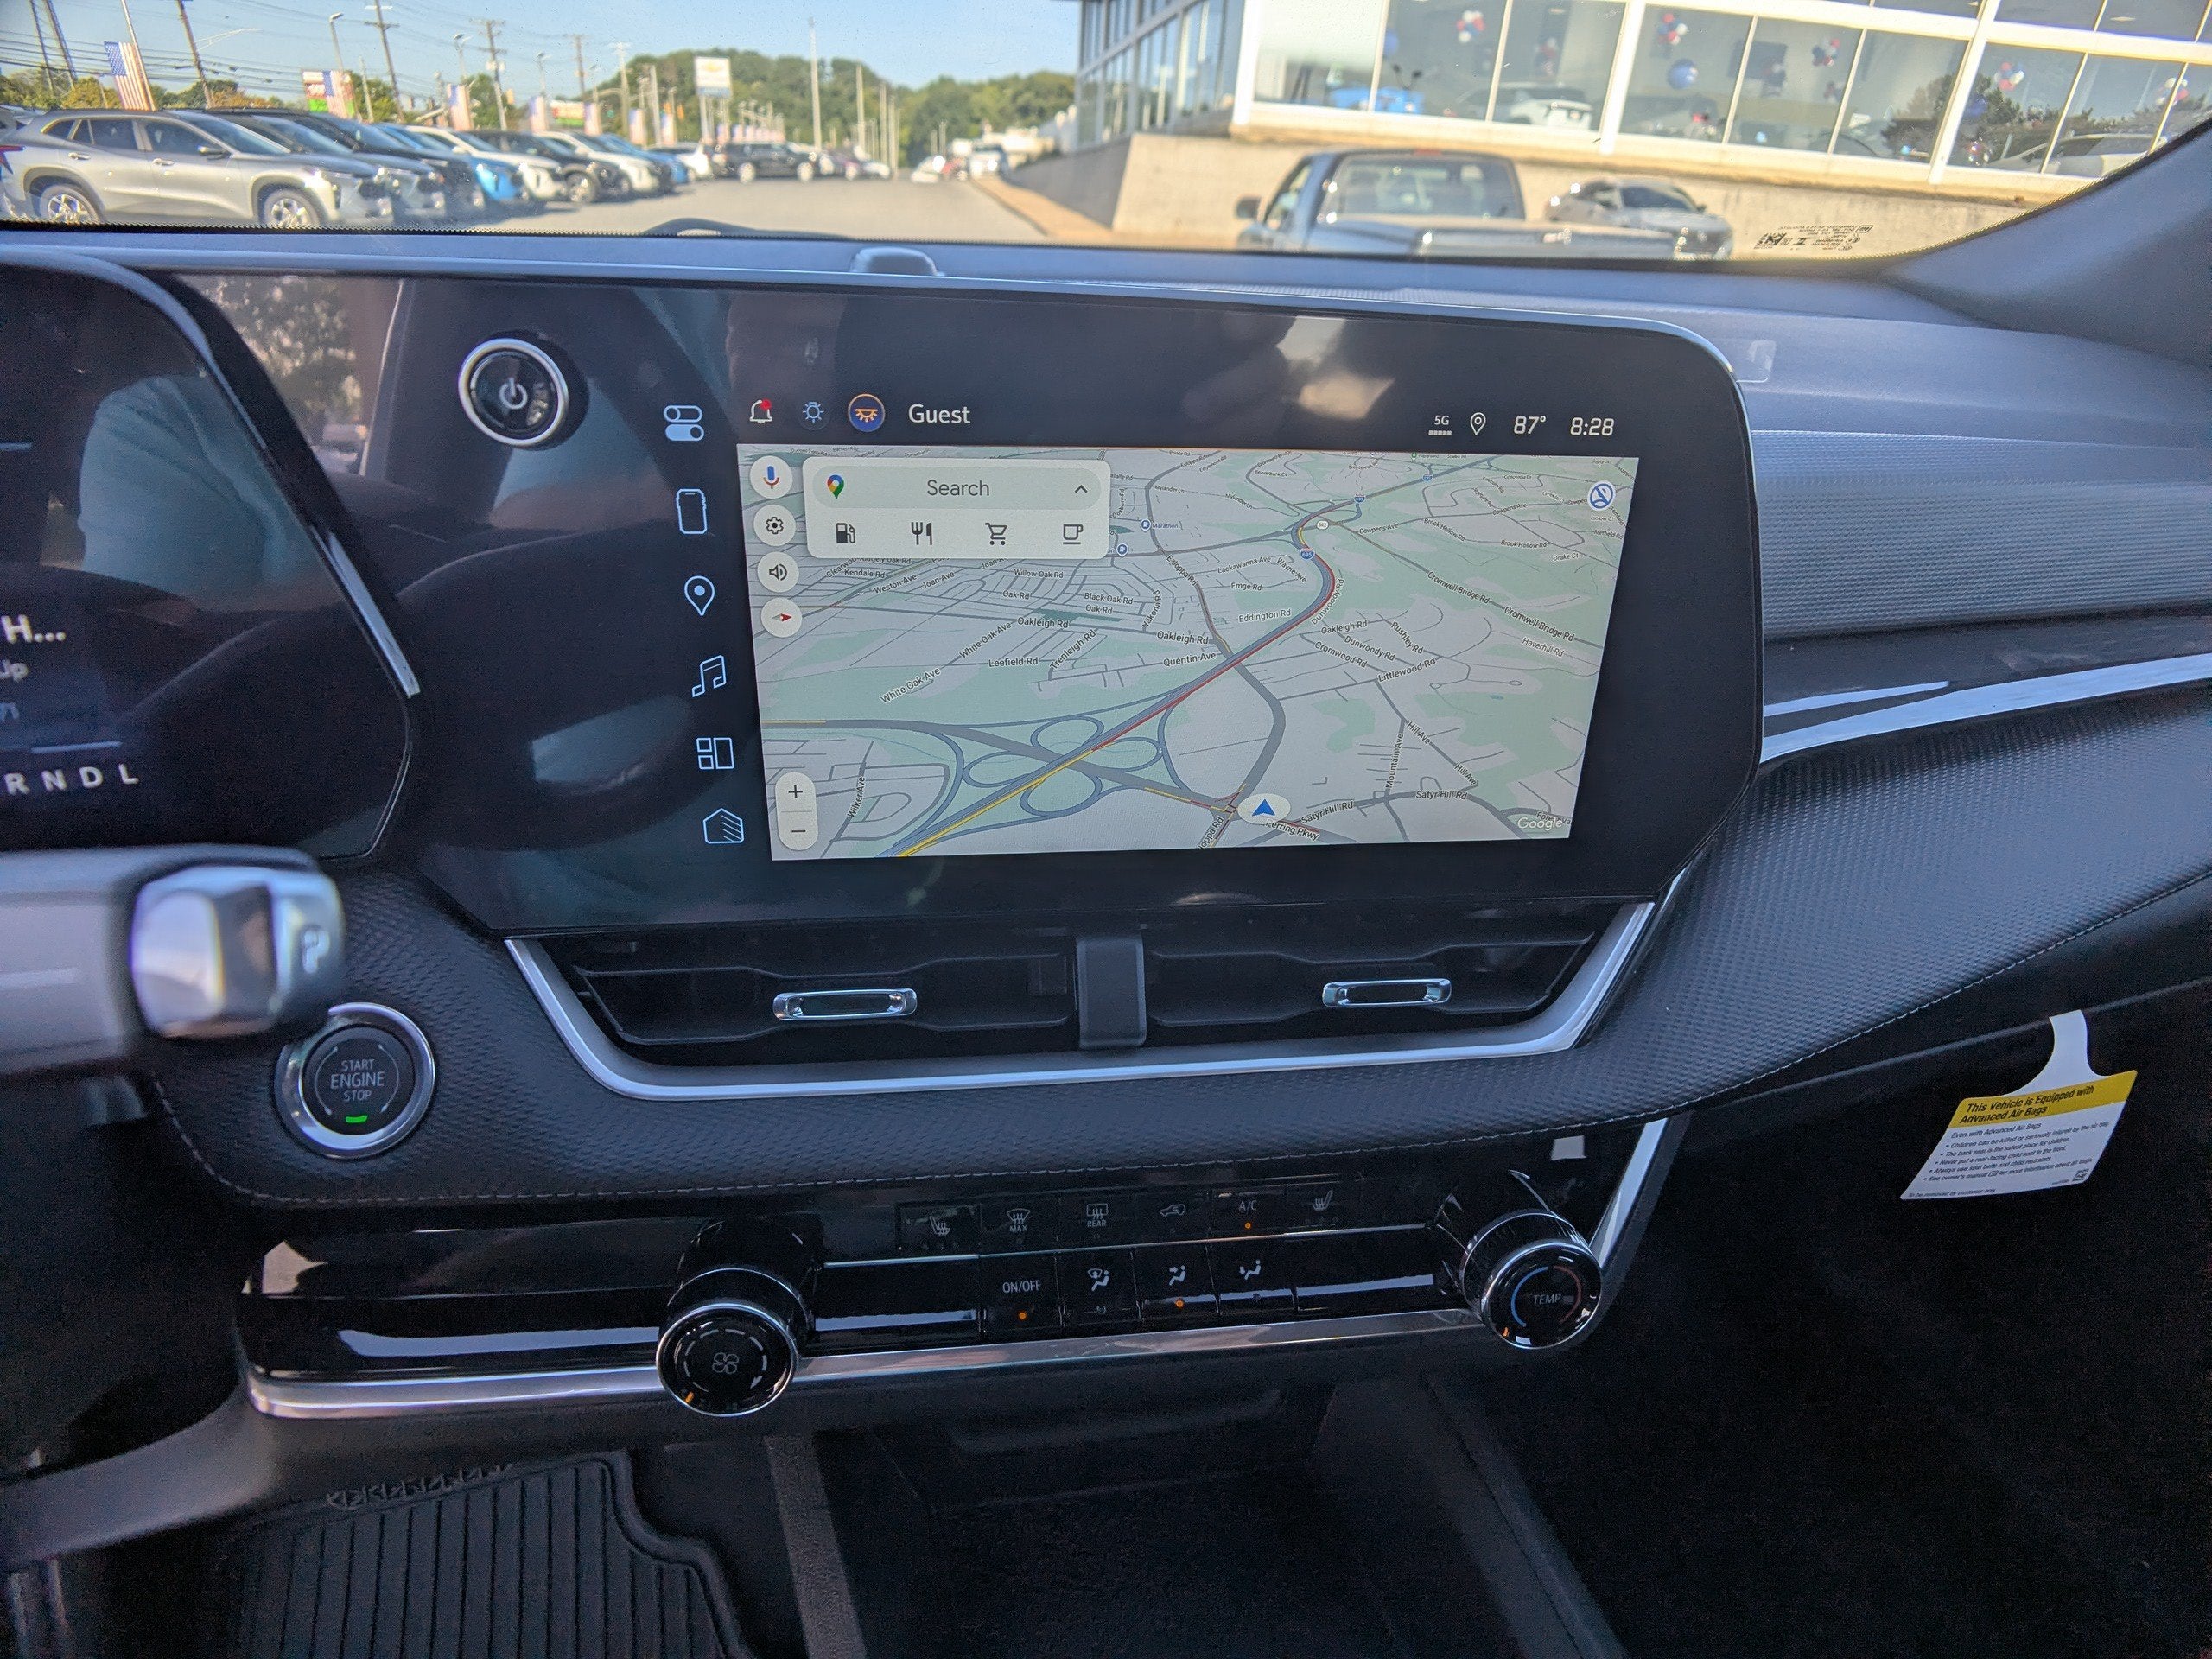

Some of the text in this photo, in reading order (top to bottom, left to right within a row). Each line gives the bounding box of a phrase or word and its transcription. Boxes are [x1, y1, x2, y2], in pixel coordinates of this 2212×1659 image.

[908, 404, 971, 424] Guest
[1434, 415, 1450, 426] 5G
[1514, 416, 1547, 435] 87°
[1570, 417, 1615, 436] 8:28
[926, 480, 990, 498] Search
[1359, 524, 1387, 534] Cowpens
[1424, 518, 1466, 542] Brook Hollow Rd
[1500, 539, 1517, 548] Brook
[843, 569, 874, 577] Kendale
[1014, 569, 1037, 577] Willow
[1217, 558, 1258, 574] Lackawanna
[1277, 557, 1306, 583] Wayne Ave
[874, 574, 918, 594] Weston Ave
[921, 571, 956, 590] Joan Ave
[1187, 574, 1198, 586] Rd
[1230, 582, 1251, 591] Emge
[1427, 571, 1491, 604] Cromwell Bridge Rd
[1084, 593, 1134, 605] Black Oak Rd
[1312, 589, 1341, 626] Dunwoody
[1085, 604, 1113, 614] Oak Rd
[1142, 589, 1161, 629] Yakona Rd
[1239, 608, 1292, 623] Eddington Rd
[1017, 617, 1069, 629] Oakleigh Rd
[1321, 623, 1355, 634] Oakleigh
[1504, 607, 1575, 641] Cromwell Bridge Rd
[959, 621, 1012, 658] White Oak Ave
[1157, 631, 1209, 645] Oakleigh Rd
[1391, 621, 1424, 654] Rushley Rd
[1050, 629, 1097, 670] Trenleigh Rd
[1315, 641, 1368, 669] Cromwood Rd
[1344, 636, 1395, 662] Dunwoody Rd
[1522, 638, 1564, 657] Haverhill Rd
[988, 657, 1039, 668] Leefield Rd
[1163, 652, 1217, 667] Quentin Ave
[1377, 657, 1436, 683] Littlewood Rd
[880, 667, 941, 703] White Oak Ave
[1407, 721, 1431, 745] Hill Ave
[1386, 734, 1403, 788] Mountain Ave
[3, 763, 139, 796] R N D L
[1455, 764, 1477, 786] Hill Ave
[847, 776, 866, 819] Wilker Ave
[1415, 790, 1439, 800] Satyr
[1455, 791, 1467, 800] Rd
[1301, 801, 1354, 824] Satyr Hill Rd
[1213, 817, 1224, 829] Rd
[1517, 817, 1563, 831] Google
[1296, 828, 1319, 842] Pkwy
[303, 929, 330, 974] P
[341, 1058, 375, 1071] START
[330, 1071, 386, 1090] ENGINE
[343, 1090, 372, 1103] STOP
[1966, 1085, 2095, 1113] This Vehicle is Equipped with
[1960, 1105, 2048, 1124] Advanced Air Bags
[1238, 1199, 1258, 1211] A/C
[1008, 1224, 1028, 1233] MAX
[1086, 1219, 1107, 1228] REAR
[1002, 1280, 1042, 1294] ON/OFF
[1533, 1293, 1562, 1306] TEMP
